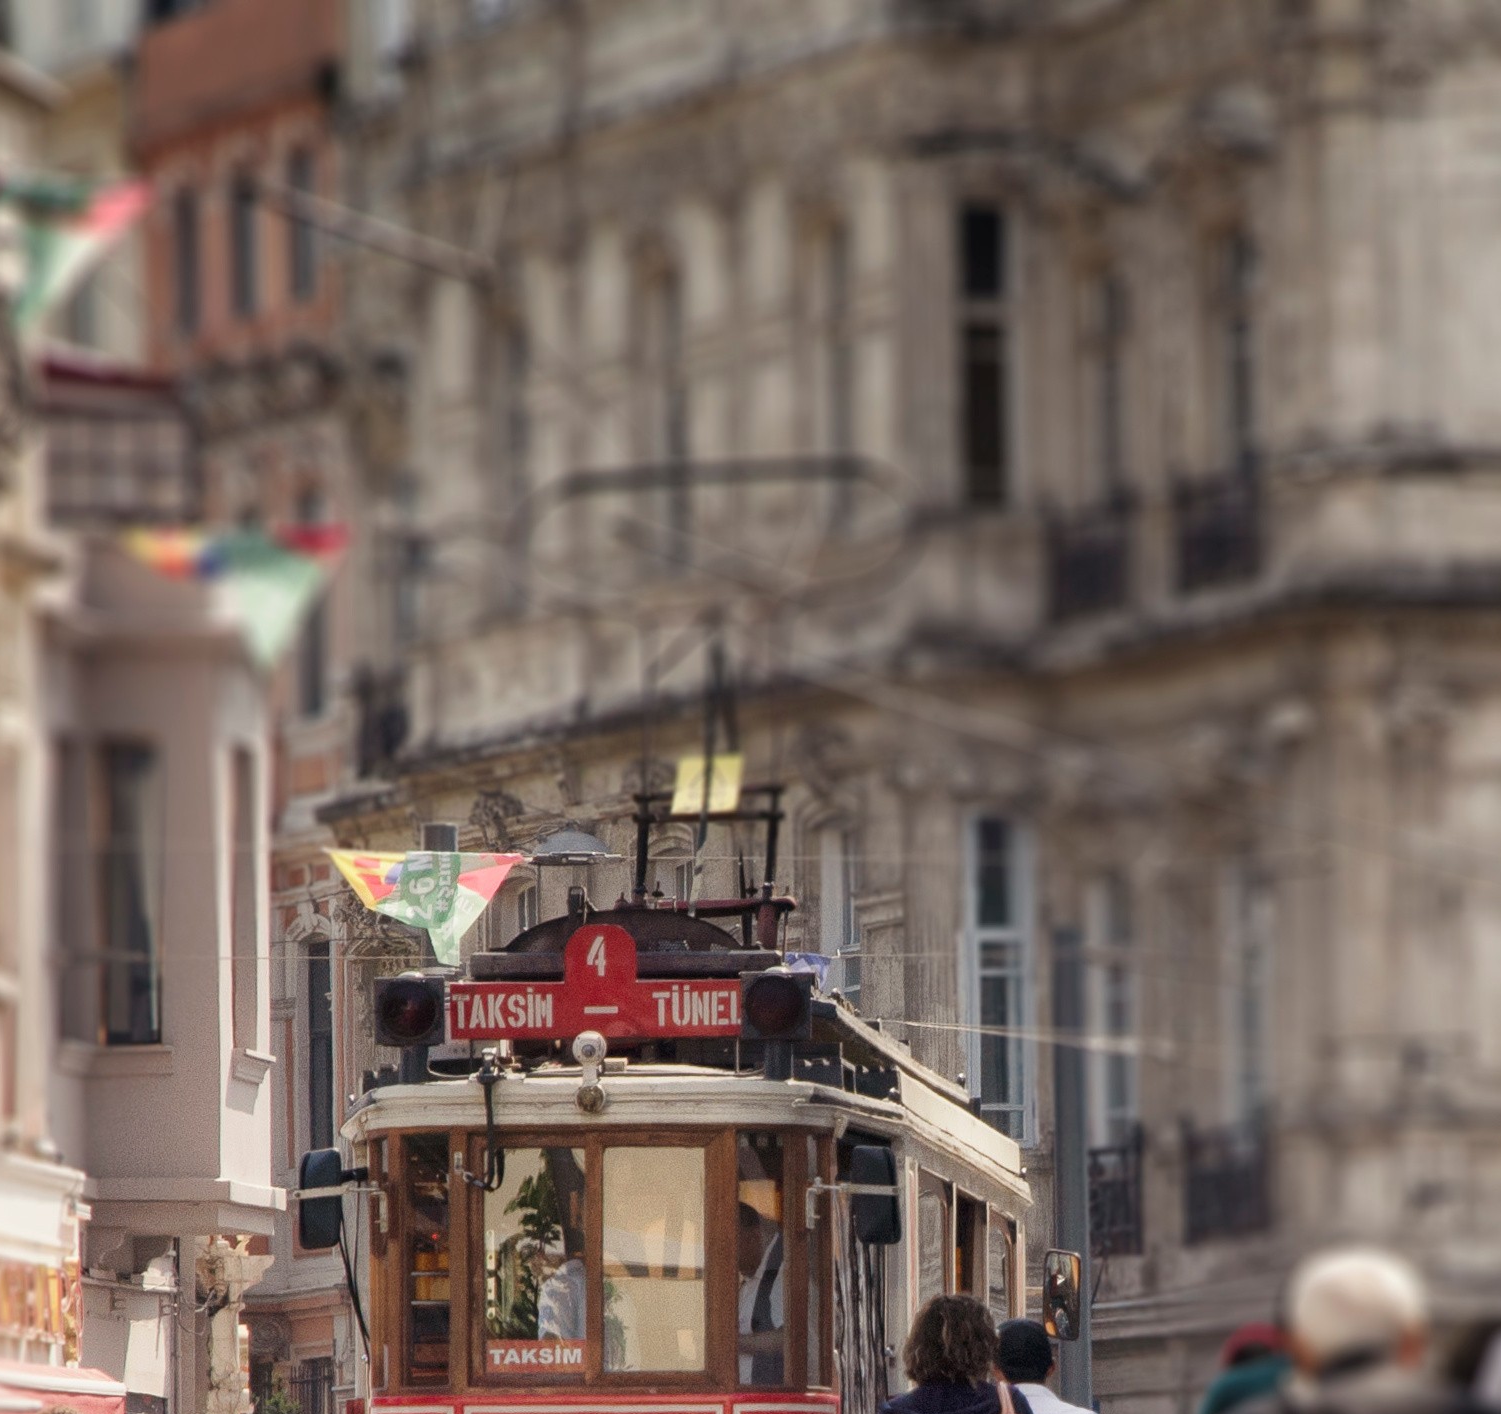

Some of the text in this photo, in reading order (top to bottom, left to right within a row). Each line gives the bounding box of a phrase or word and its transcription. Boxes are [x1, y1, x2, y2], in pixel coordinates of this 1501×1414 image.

[586, 935, 607, 977] 4
[452, 987, 554, 1030] TAKSİM
[652, 984, 741, 1028] TÜNEL
[489, 1344, 582, 1365] TAKSİM
